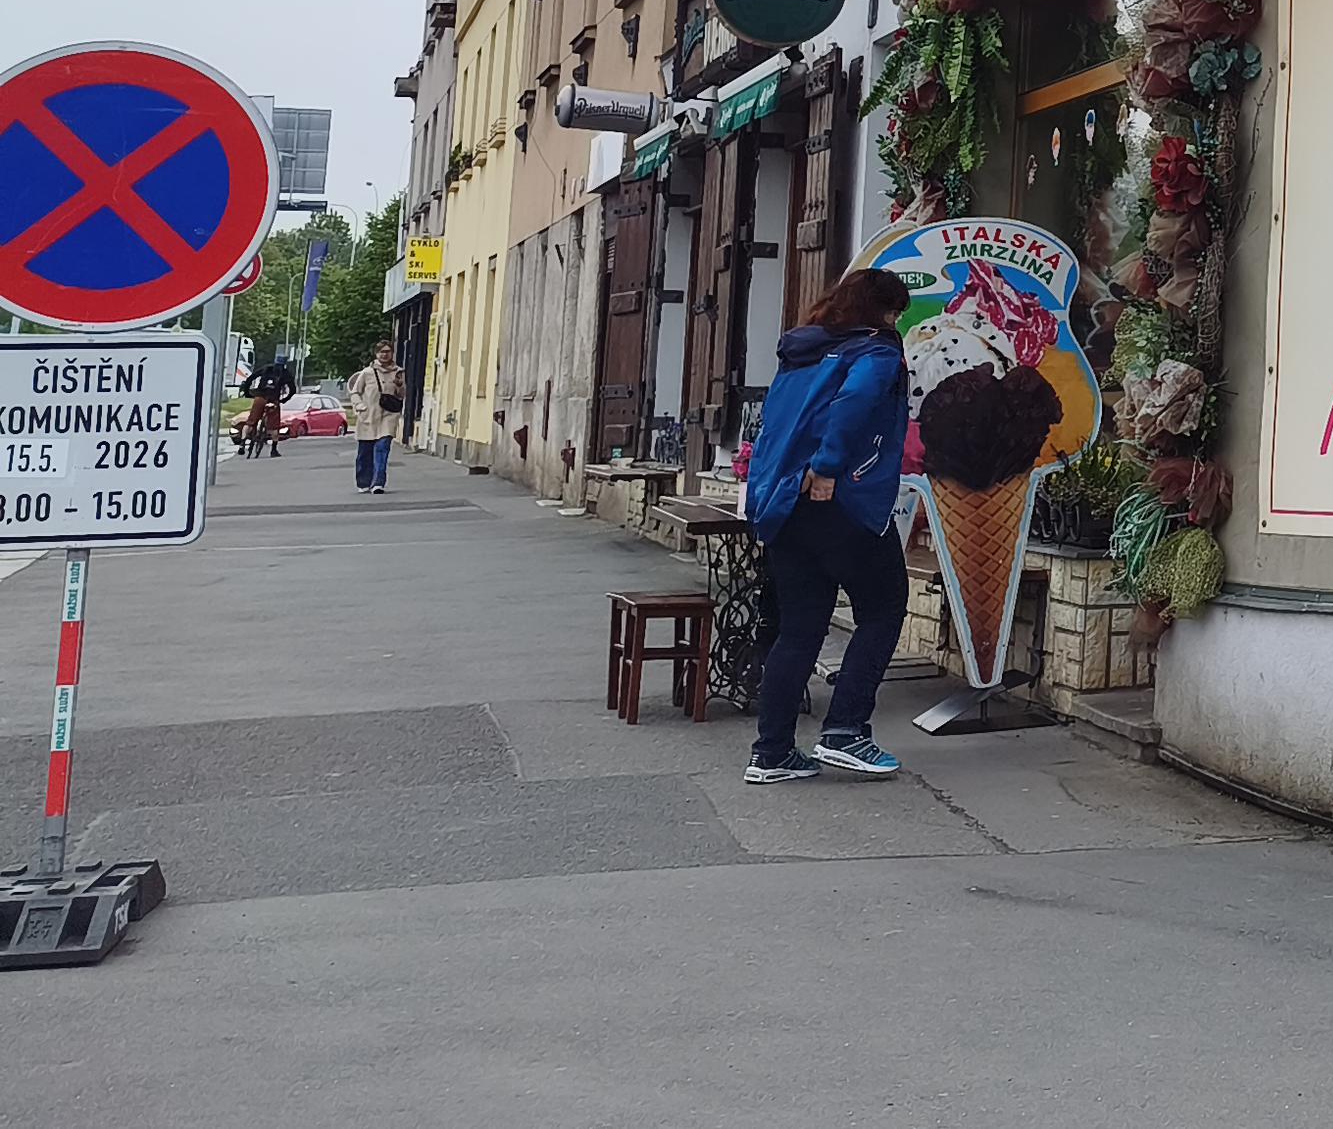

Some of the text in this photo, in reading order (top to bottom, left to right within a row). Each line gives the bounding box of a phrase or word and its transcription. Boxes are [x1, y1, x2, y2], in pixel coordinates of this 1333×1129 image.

[574, 97, 646, 119] Pilsner Urquell
[409, 250, 416, 258] &
[410, 239, 440, 248] CYKLO
[941, 226, 1064, 271] ITALSKÁ
[407, 271, 438, 280] SERVIS
[408, 261, 424, 269] SKI
[944, 243, 1055, 286] ZMRZLINA
[32, 356, 149, 394] ČIŠTĚNÍ
[6, 439, 169, 473] 15.5. 2026
[92, 489, 167, 522] 15,00
[70, 561, 82, 584] SLUŽB
